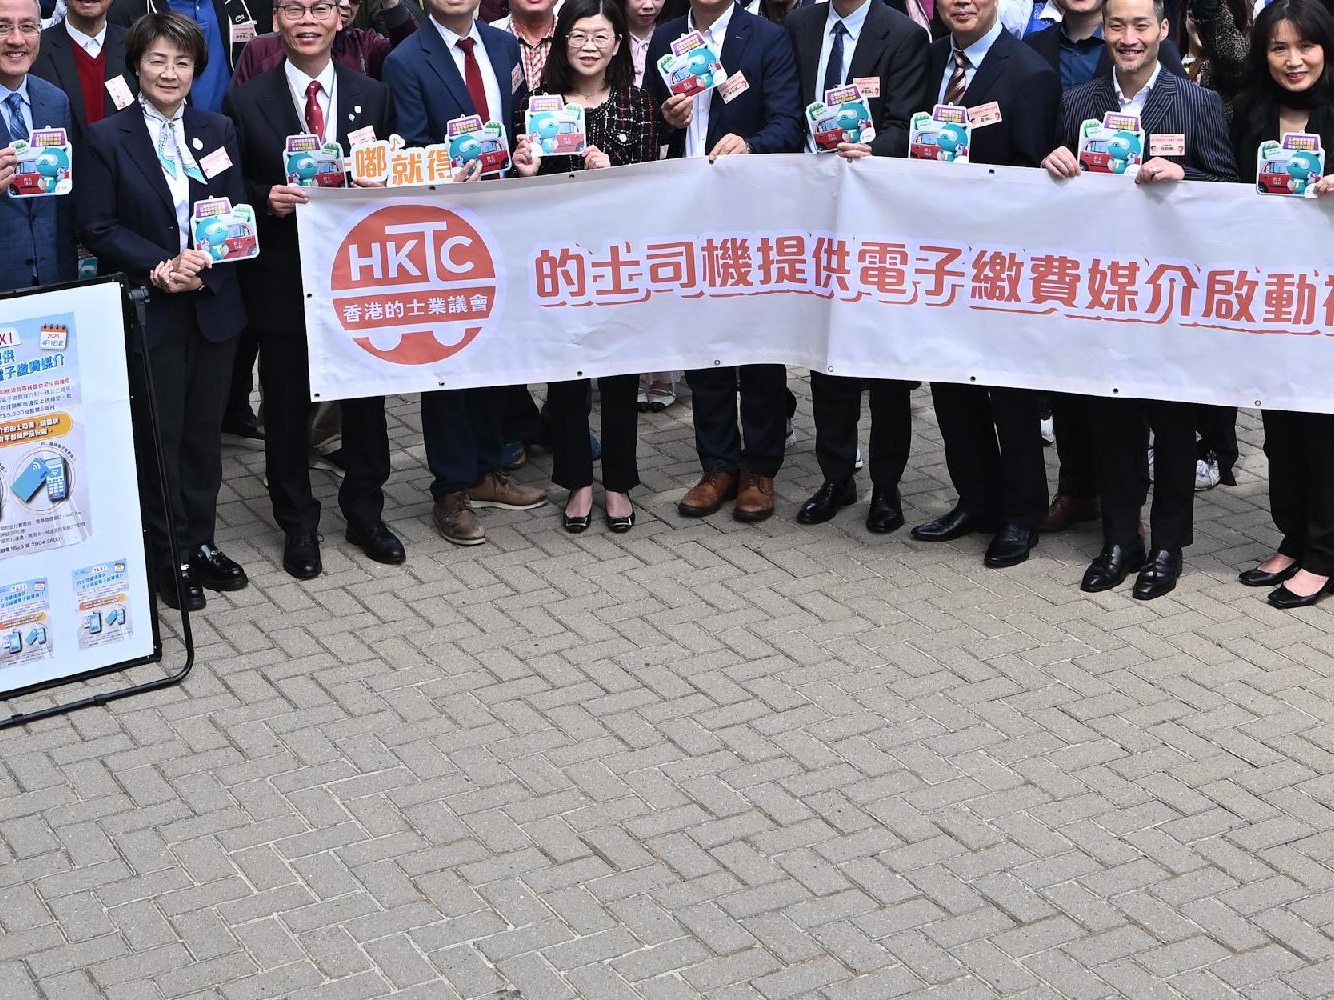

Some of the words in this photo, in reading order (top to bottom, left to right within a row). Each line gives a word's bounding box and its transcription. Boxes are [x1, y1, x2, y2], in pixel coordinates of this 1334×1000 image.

[344, 144, 453, 185] 嘟就得
[348, 220, 475, 284] HKTC
[342, 294, 489, 324] 香港的士業議會
